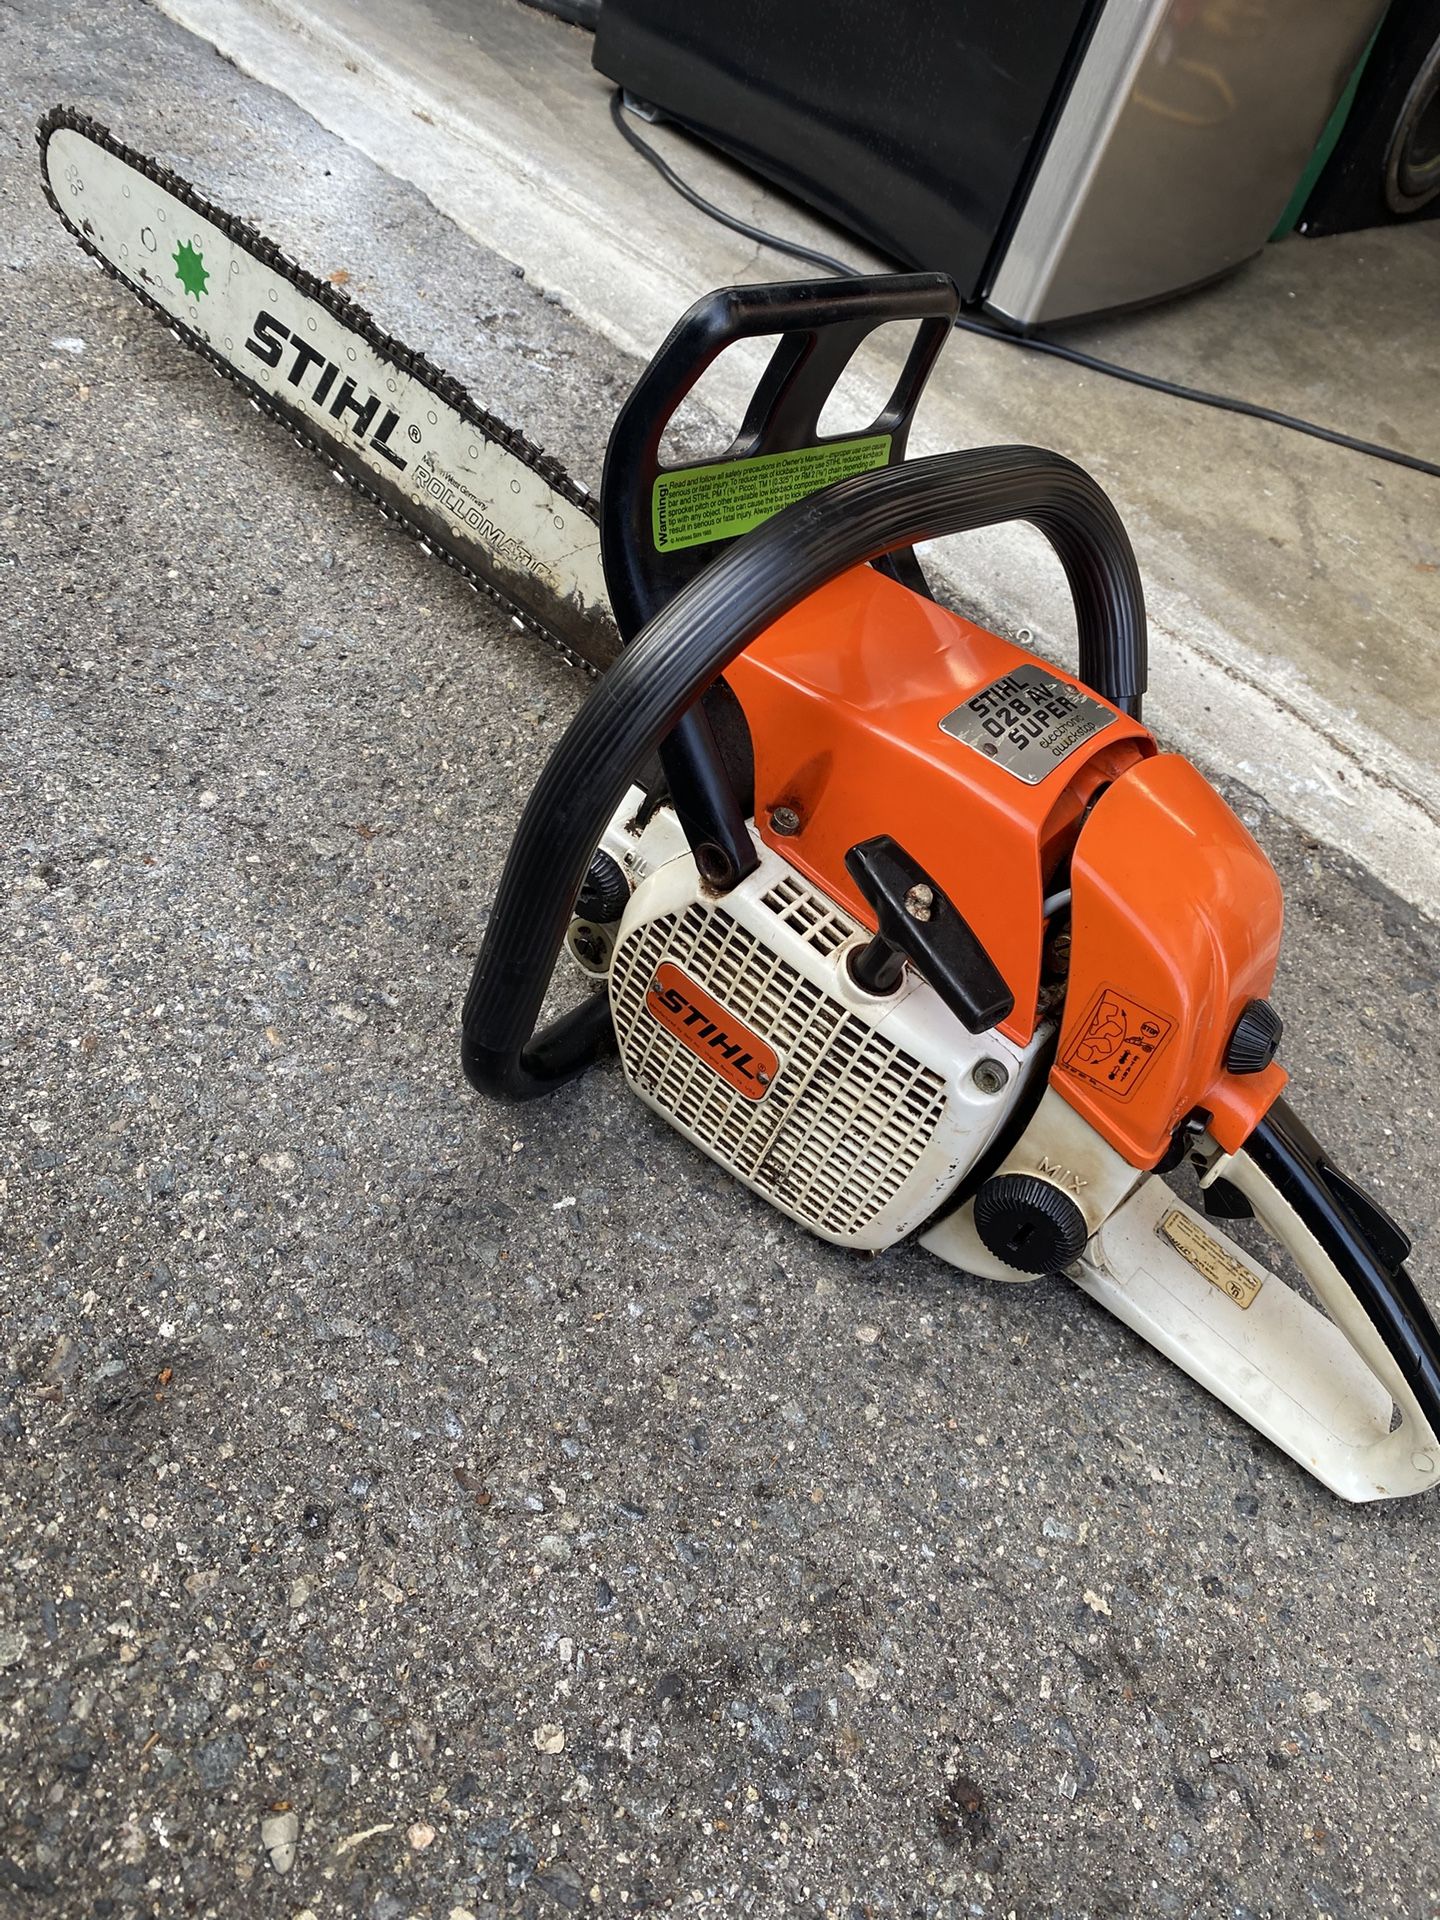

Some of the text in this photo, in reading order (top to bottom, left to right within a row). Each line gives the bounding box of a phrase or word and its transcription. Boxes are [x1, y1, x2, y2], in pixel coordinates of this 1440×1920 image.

[245, 310, 408, 471] STIHL
[776, 467, 798, 475] kickback
[826, 457, 840, 466] STIHL
[668, 505, 693, 516] sprocket
[695, 502, 708, 511] pitch
[770, 484, 791, 494] kickback
[669, 480, 685, 488] Read
[692, 492, 709, 501] STIHL
[659, 484, 668, 545] Warning!
[669, 524, 685, 533] result
[694, 519, 714, 528] serious
[754, 506, 772, 514] Always
[968, 676, 1030, 718] STIHL
[982, 683, 1055, 738] 028 AV
[1008, 696, 1078, 751] SUPER
[1039, 715, 1085, 749] electronic
[1052, 721, 1096, 757] quickstop
[658, 989, 754, 1080] STIHL
[1141, 1023, 1159, 1036] STOP
[1120, 1055, 1139, 1082] START
[1038, 1156, 1088, 1194] MIX
